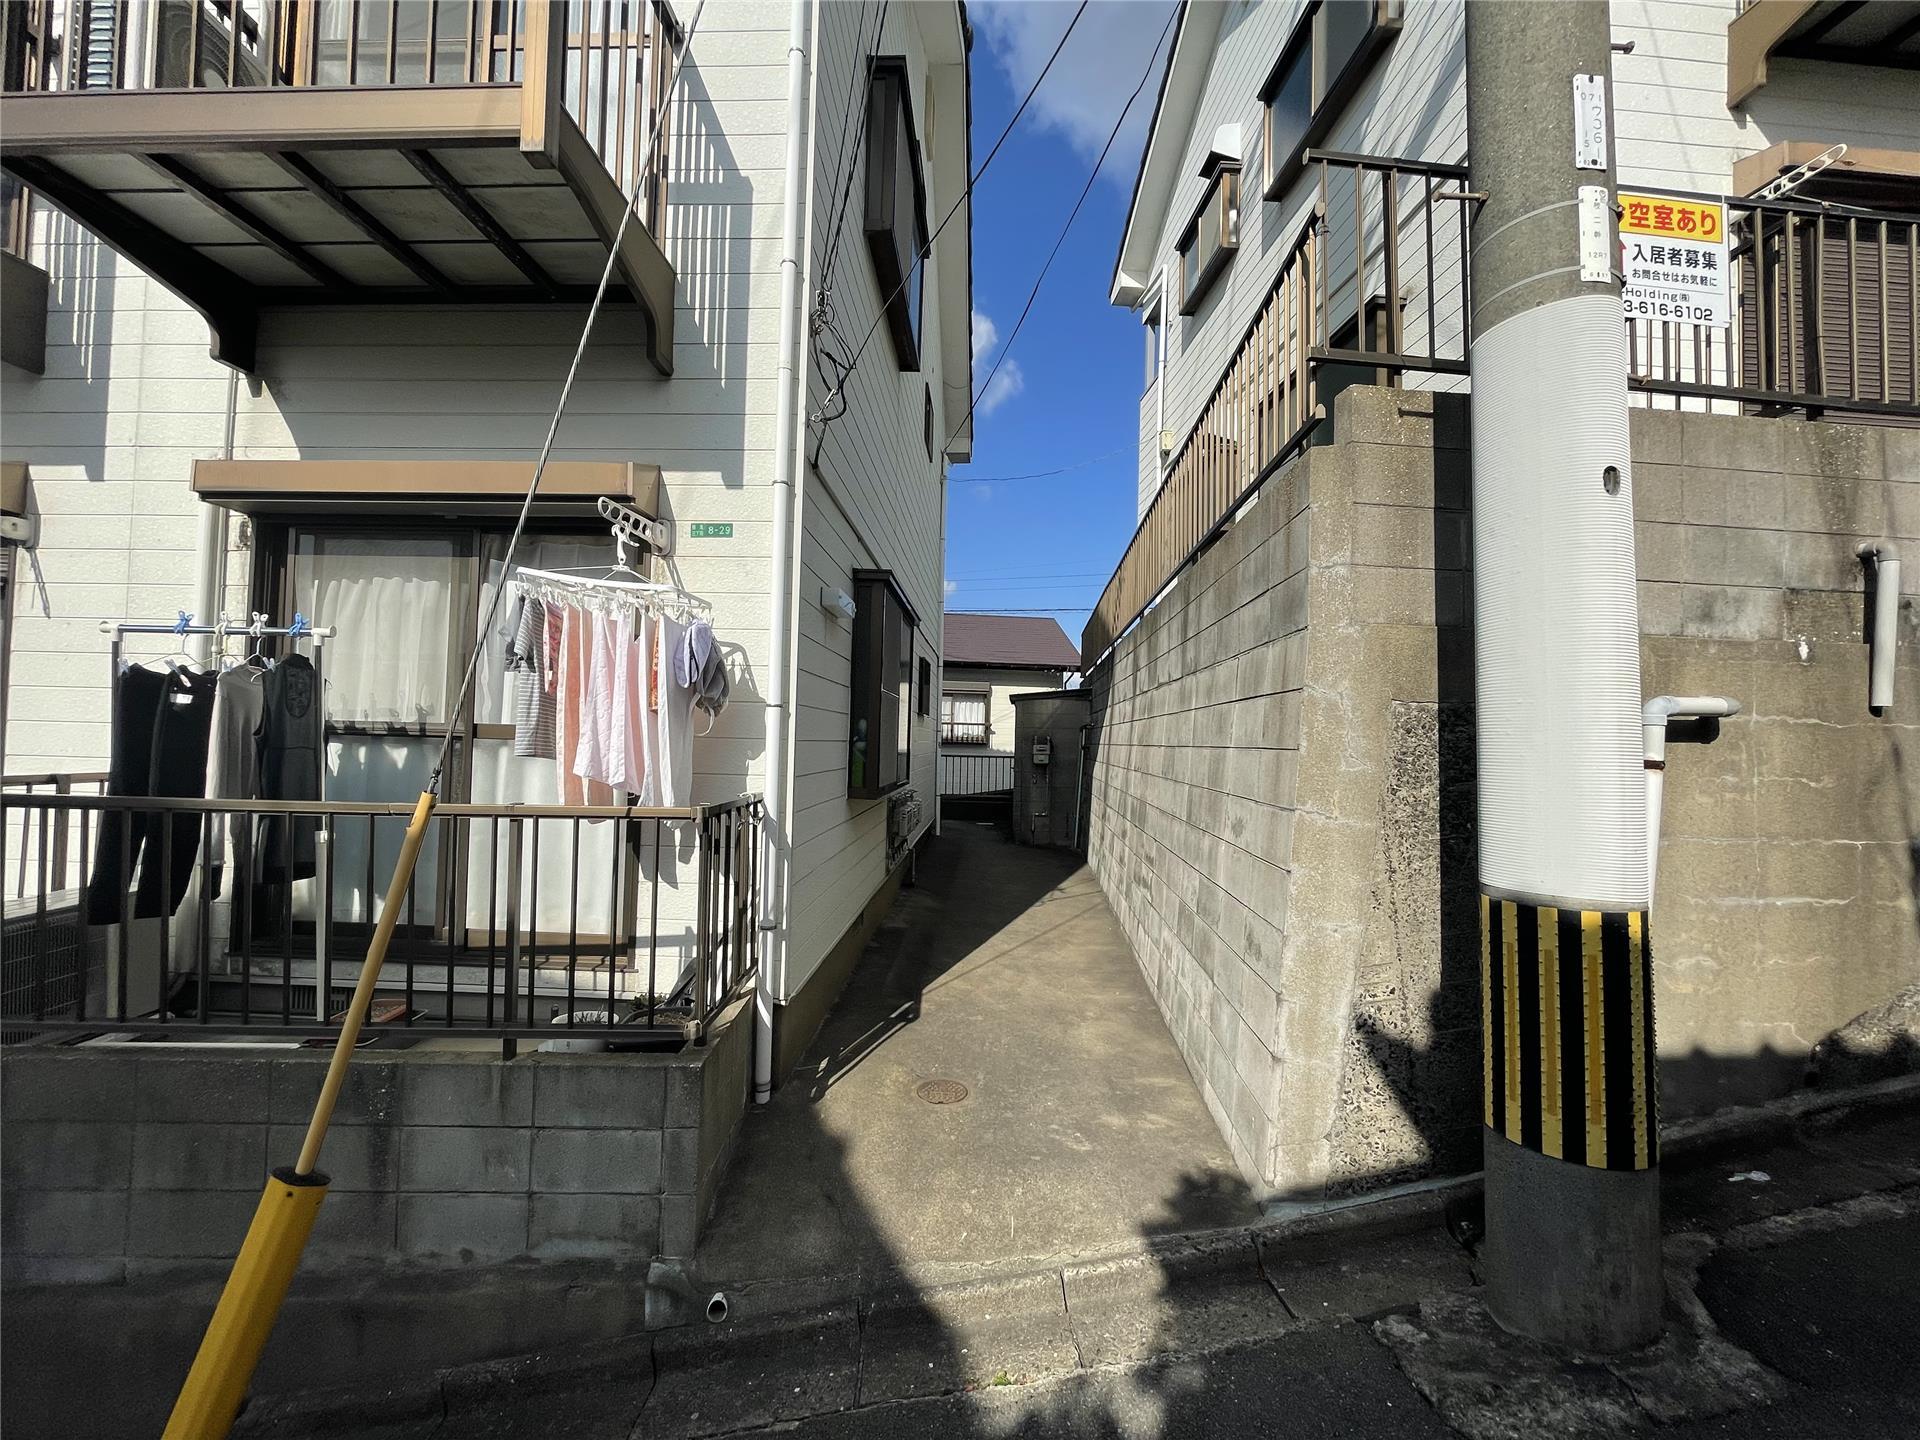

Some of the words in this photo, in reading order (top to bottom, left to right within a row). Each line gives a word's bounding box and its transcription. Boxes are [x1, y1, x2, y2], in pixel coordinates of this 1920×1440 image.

[1628, 202, 1716, 236] 空室あり
[1632, 243, 1718, 271] 入居者募集
[1631, 268, 1718, 287] お問合せはお気軽に
[708, 525, 731, 535] 8-29
